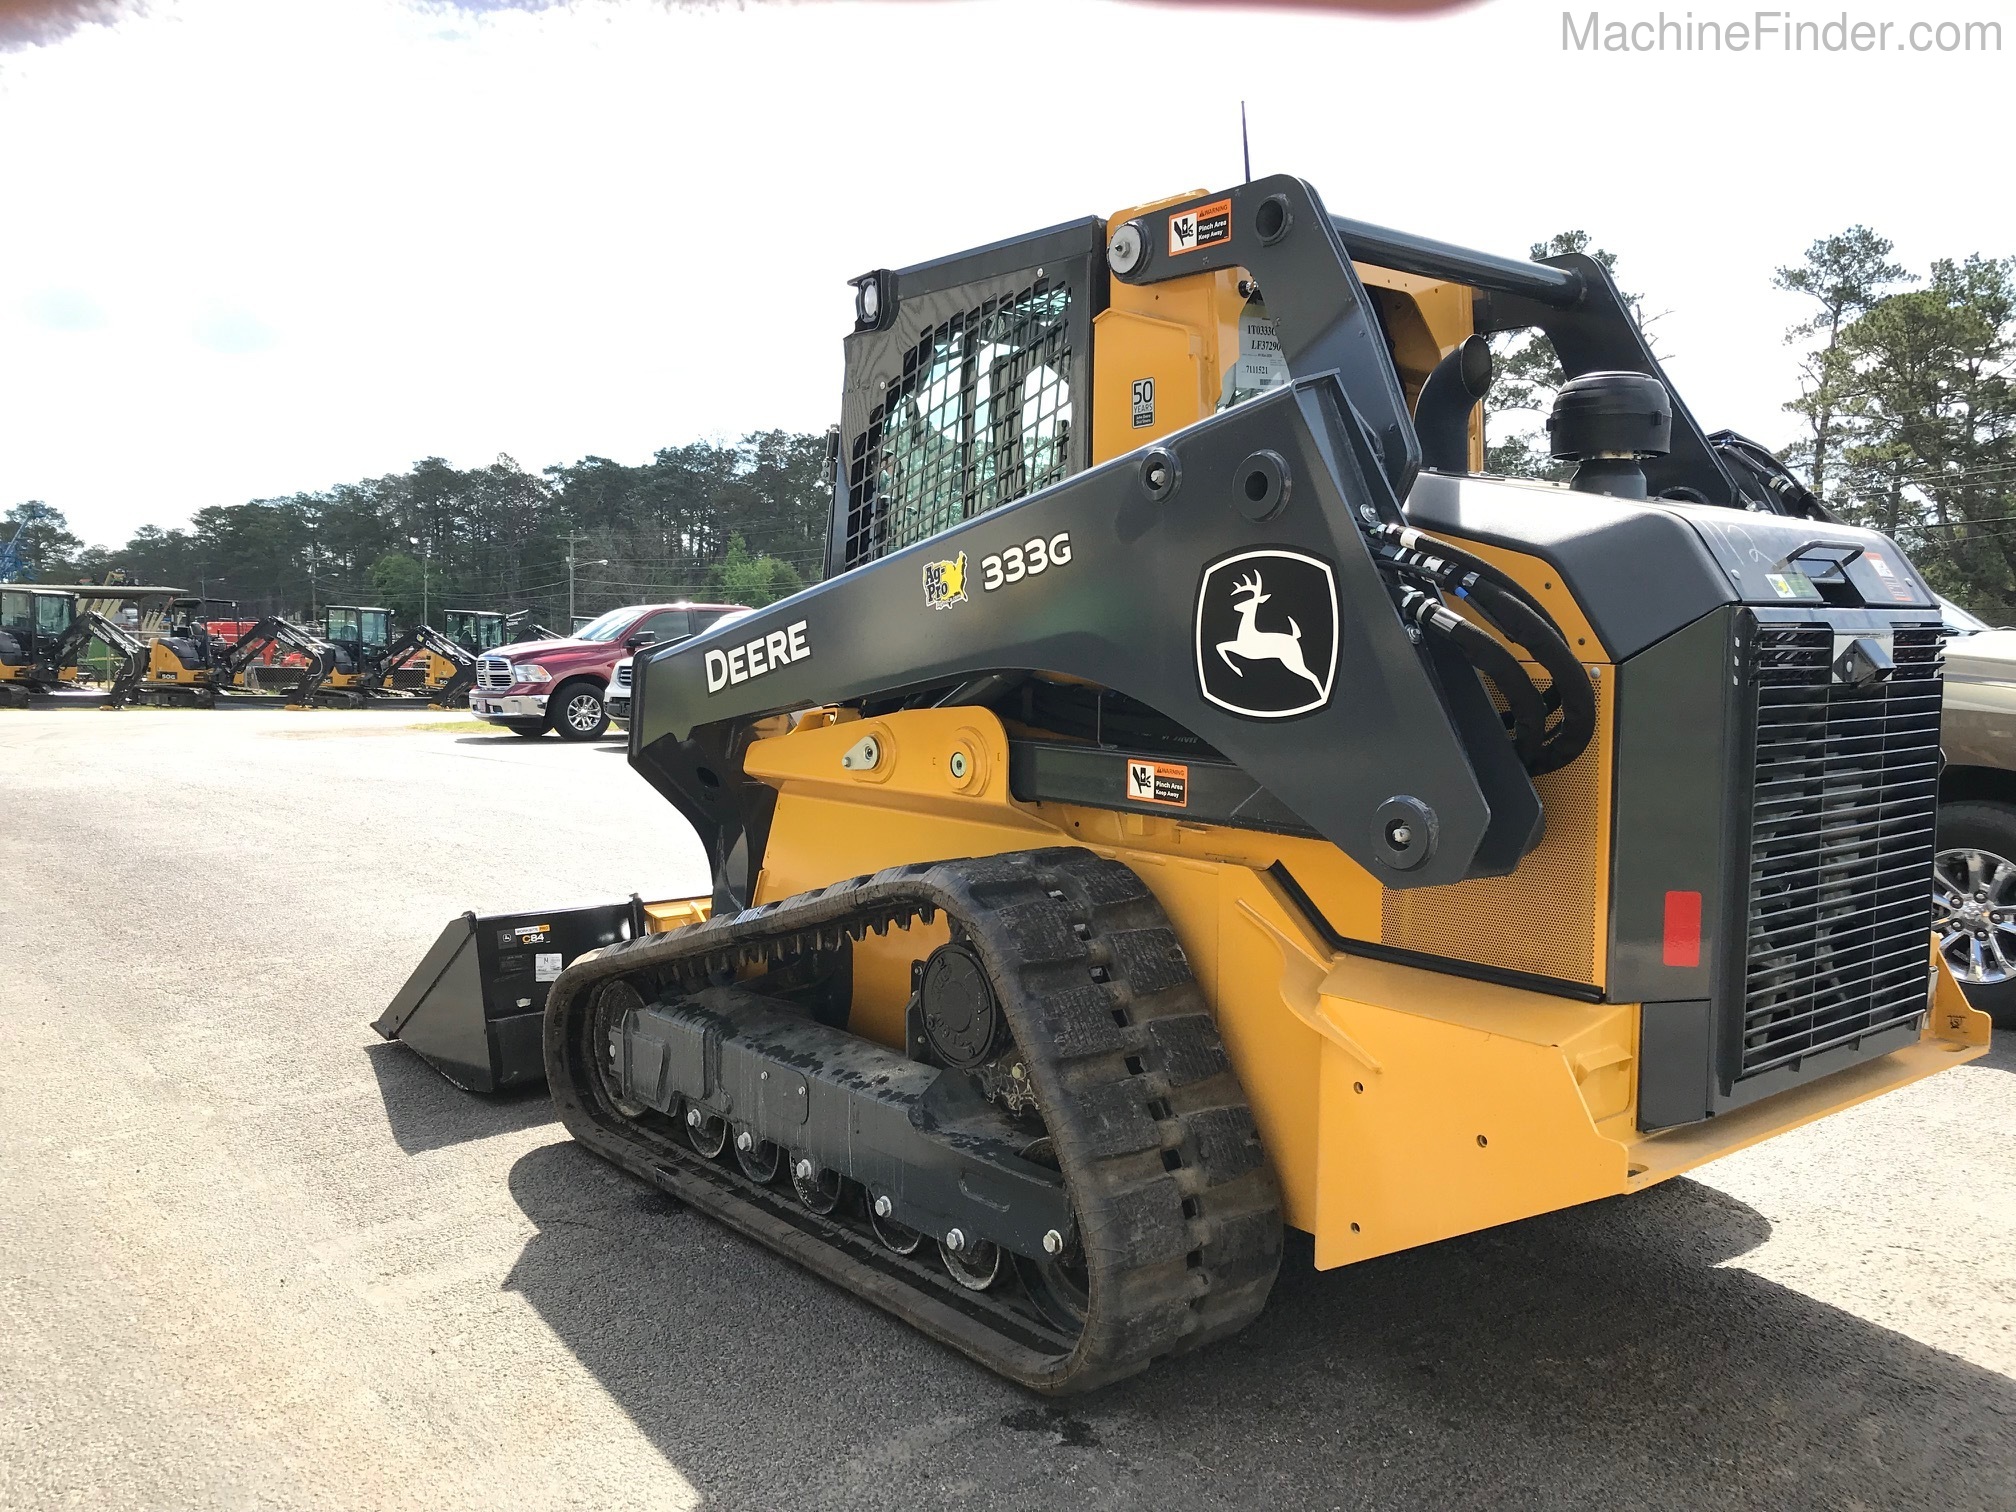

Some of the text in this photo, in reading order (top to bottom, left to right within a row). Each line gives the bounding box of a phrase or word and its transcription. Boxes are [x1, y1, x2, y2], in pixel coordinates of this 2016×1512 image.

[1204, 204, 1228, 216] WARNING
[1198, 220, 1227, 232] Pinch Area
[1198, 230, 1223, 241] Keep Away
[1246, 364, 1268, 375] 7111521
[1133, 380, 1153, 405] 50
[1133, 402, 1153, 414] YEARS
[981, 532, 1072, 591] 333G
[925, 565, 945, 585] Ag-
[926, 581, 948, 602] Pro
[704, 619, 811, 693] DEERE
[1161, 768, 1184, 776] WARNING
[1156, 780, 1183, 791] Pinch Area
[522, 933, 544, 943] C84
